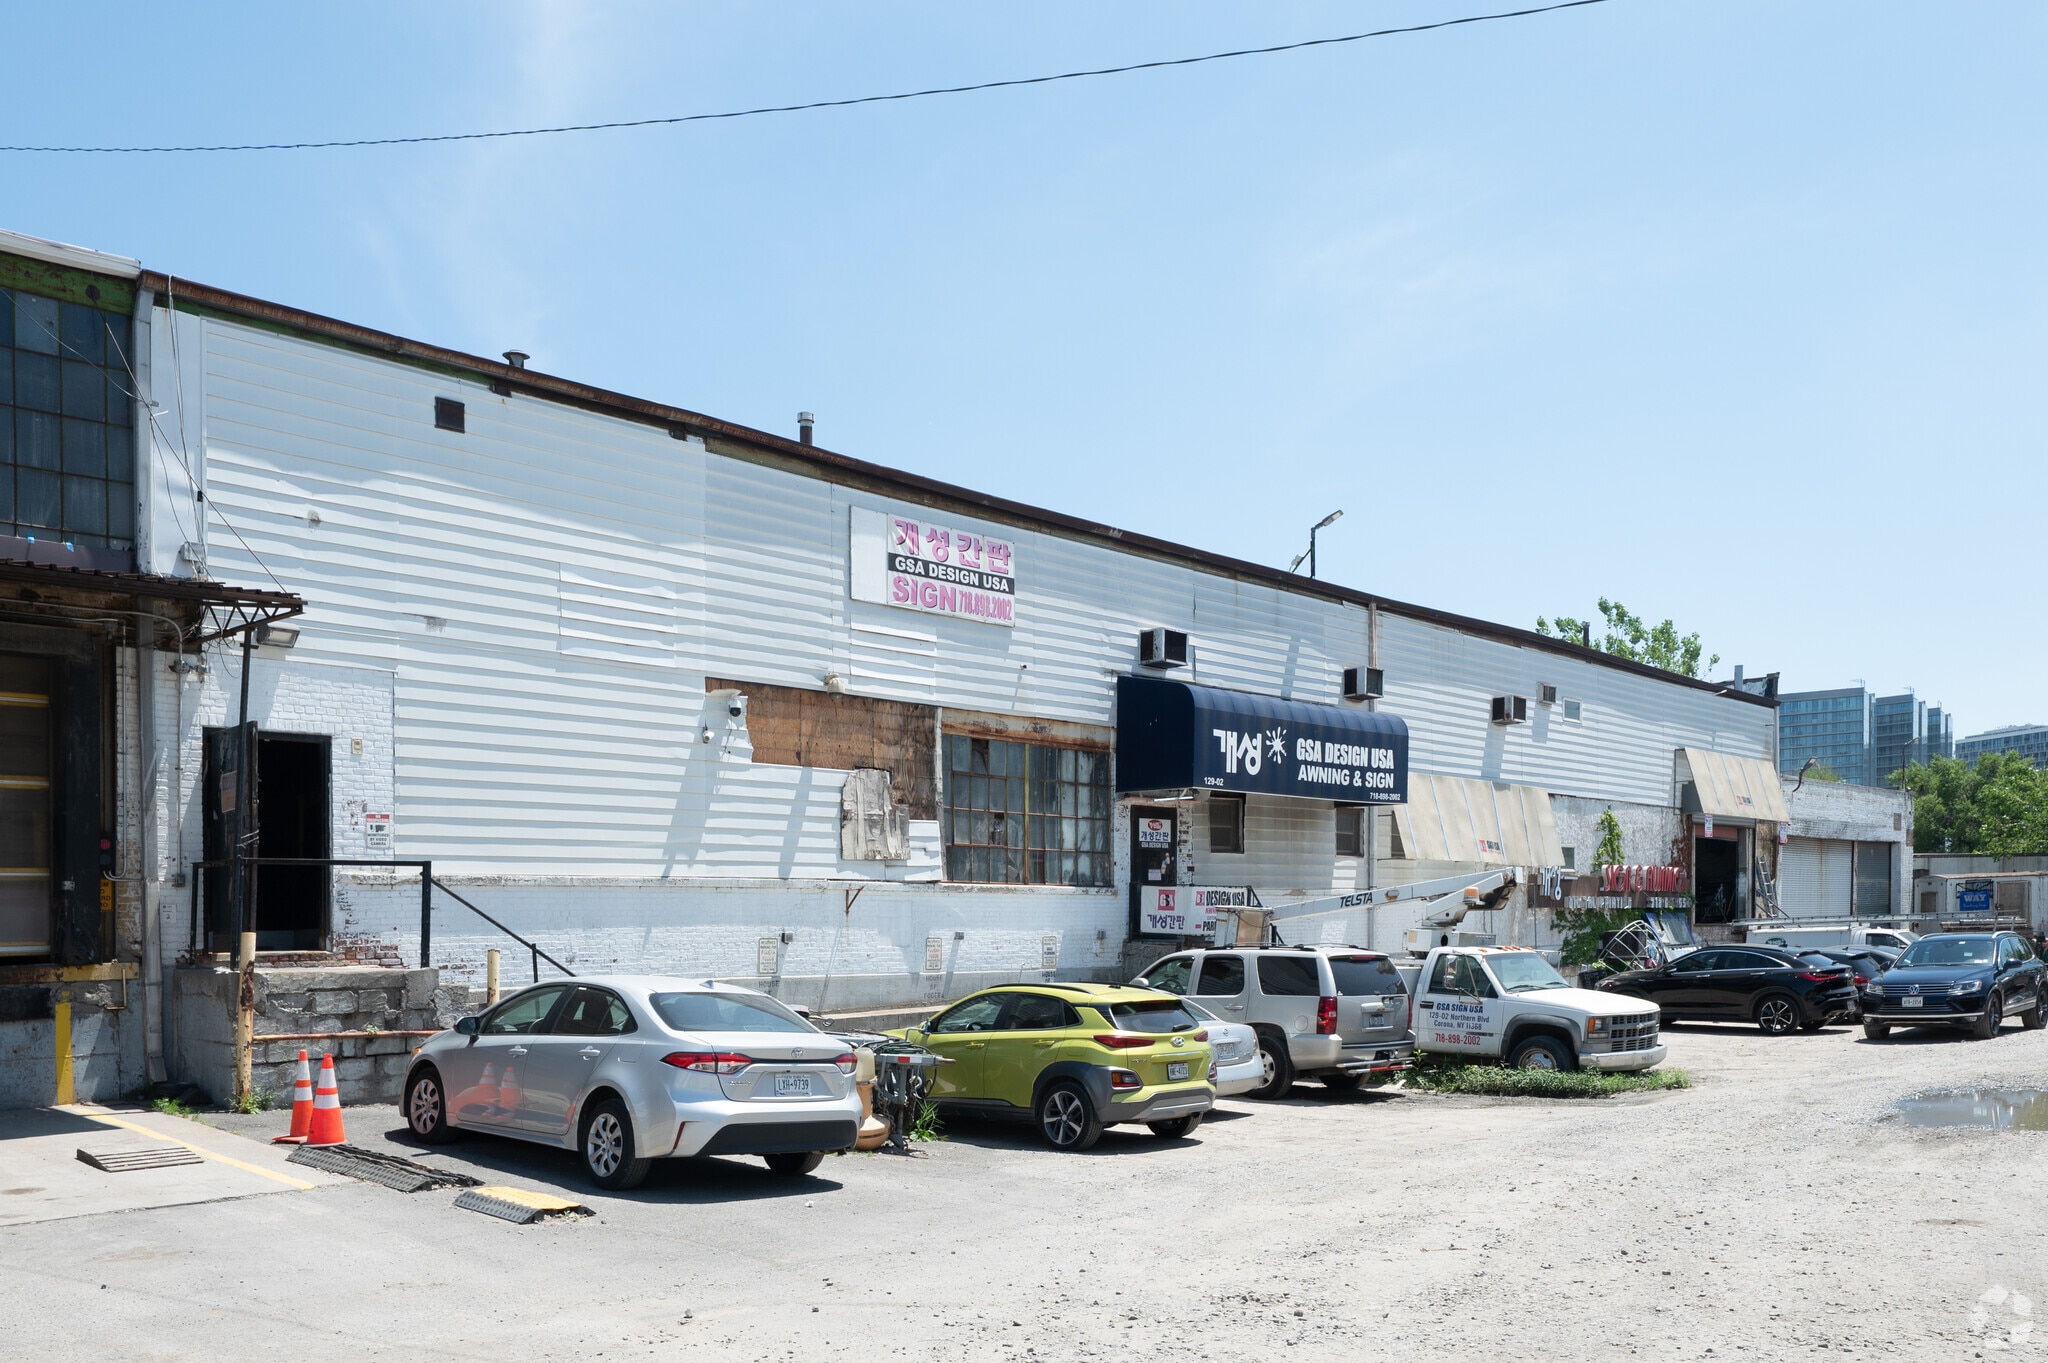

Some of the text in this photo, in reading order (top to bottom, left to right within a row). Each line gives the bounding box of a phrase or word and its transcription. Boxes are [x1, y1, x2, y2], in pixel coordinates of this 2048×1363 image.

[894, 519, 1011, 575] 개성간판
[894, 556, 1009, 592] GSA DESIGN USA
[892, 576, 1012, 621] SIGN 718.898.2002
[1212, 728, 1262, 776] 개성
[1296, 738, 1394, 769] GSA DESIGN USA
[1204, 776, 1224, 787] 129-02
[1297, 764, 1394, 789] AWNING & SIGN
[1369, 792, 1401, 801] 718-898-2002
[1206, 890, 1231, 906] DESIGN
[1232, 892, 1246, 906] USA
[1340, 892, 1373, 908] TELSTA
[1436, 1002, 1483, 1014] GSA SIGN USA
[1429, 1011, 1490, 1023] 129-02 Northern Blvd
[1433, 1020, 1455, 1028] Corona,
[1435, 1032, 1481, 1046] 718-898-2002
